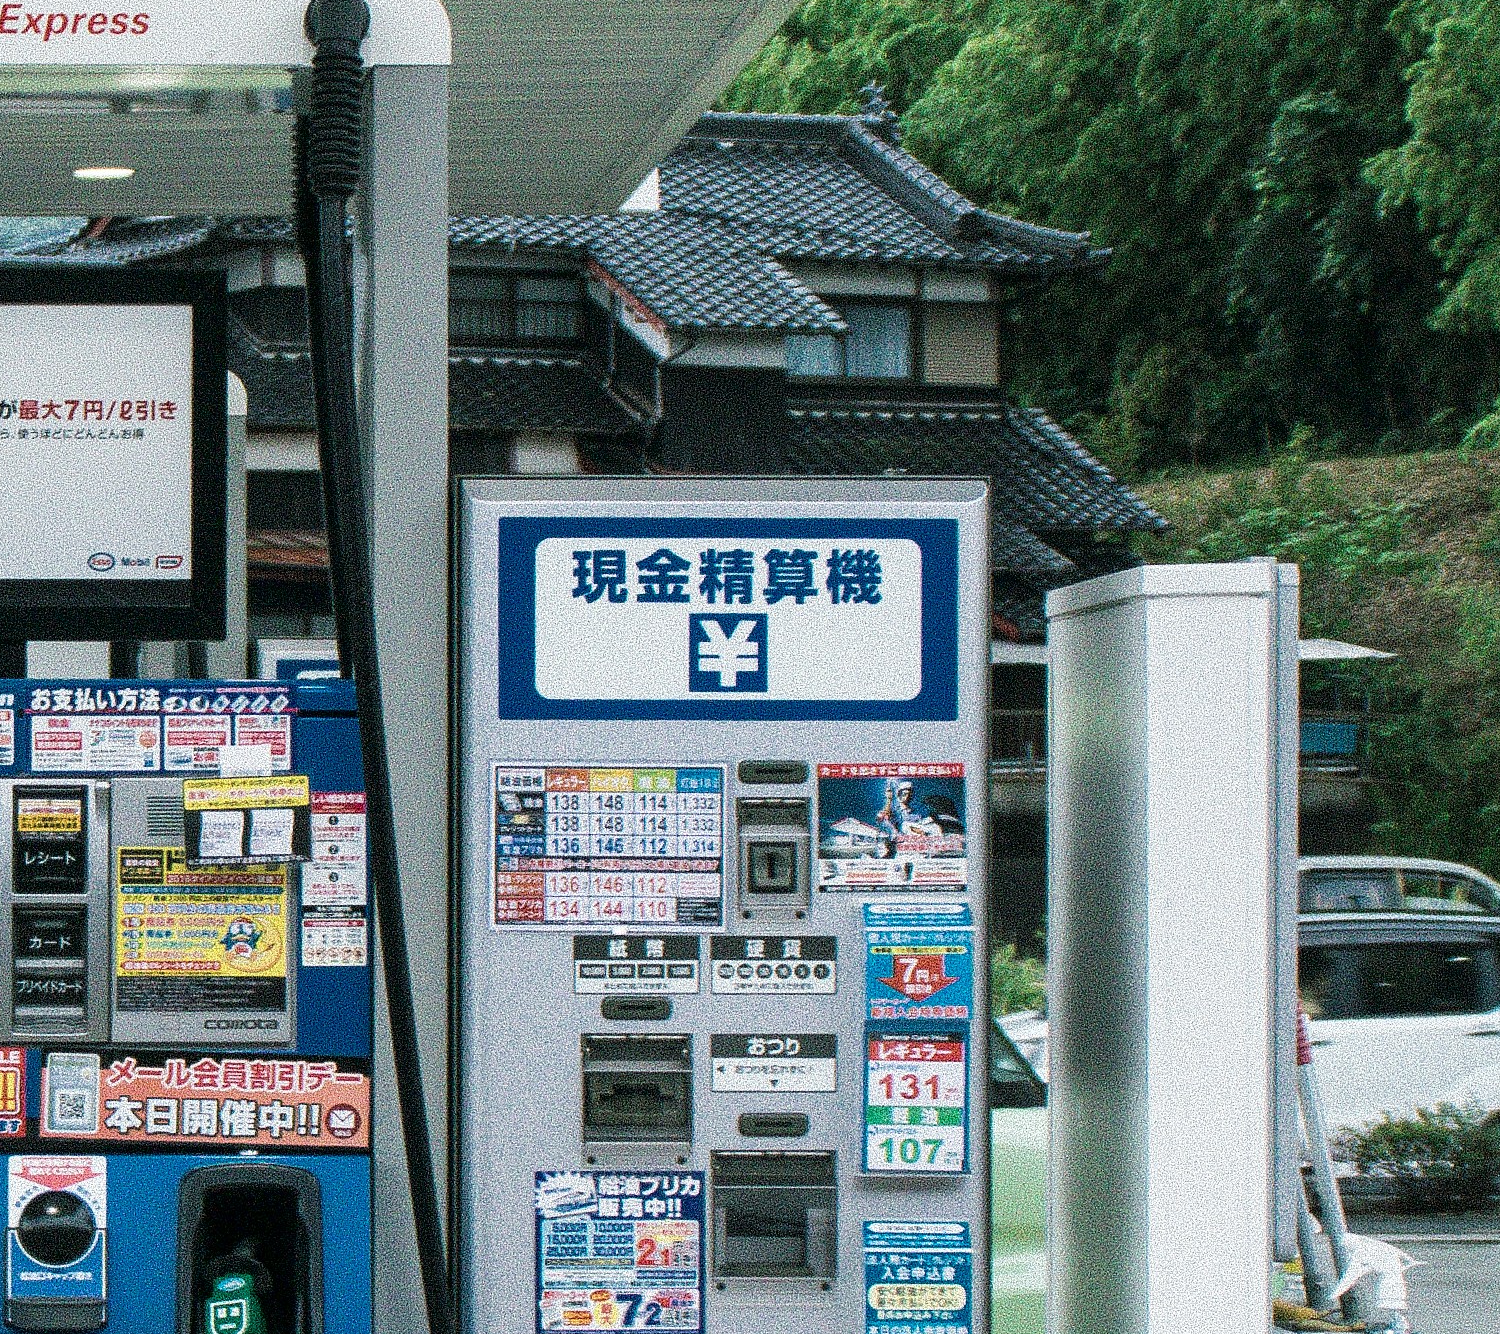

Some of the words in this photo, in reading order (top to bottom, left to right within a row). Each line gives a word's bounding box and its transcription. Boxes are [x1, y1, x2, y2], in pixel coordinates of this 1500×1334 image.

[571, 548, 883, 606] 現金精算機
[697, 619, 760, 688] ¥
[30, 688, 161, 712] お支払い方法
[552, 795, 580, 811] 138
[596, 795, 624, 811] 148
[640, 795, 667, 811] 114
[682, 795, 716, 811] 1,332
[552, 817, 580, 832] 138
[596, 817, 624, 832] 148
[640, 817, 667, 832] 114
[682, 817, 716, 832] 1,332
[552, 838, 580, 854] 136
[596, 838, 624, 854] 146
[640, 838, 667, 854] 112
[682, 838, 716, 854] 1,314
[24, 850, 77, 866] レシート
[550, 877, 580, 893] 136
[594, 877, 624, 893] 146
[638, 877, 667, 893] 112
[550, 901, 580, 918] 134
[594, 901, 624, 918] 144
[638, 901, 667, 918] 110
[29, 936, 73, 951] カード
[747, 1037, 800, 1055] おつり
[877, 1042, 952, 1061] レギュラー
[108, 1058, 362, 1092] メール会員割引デー
[878, 1074, 940, 1100] 131
[105, 1097, 321, 1138] 本日開催中!!
[878, 1138, 944, 1164] 107
